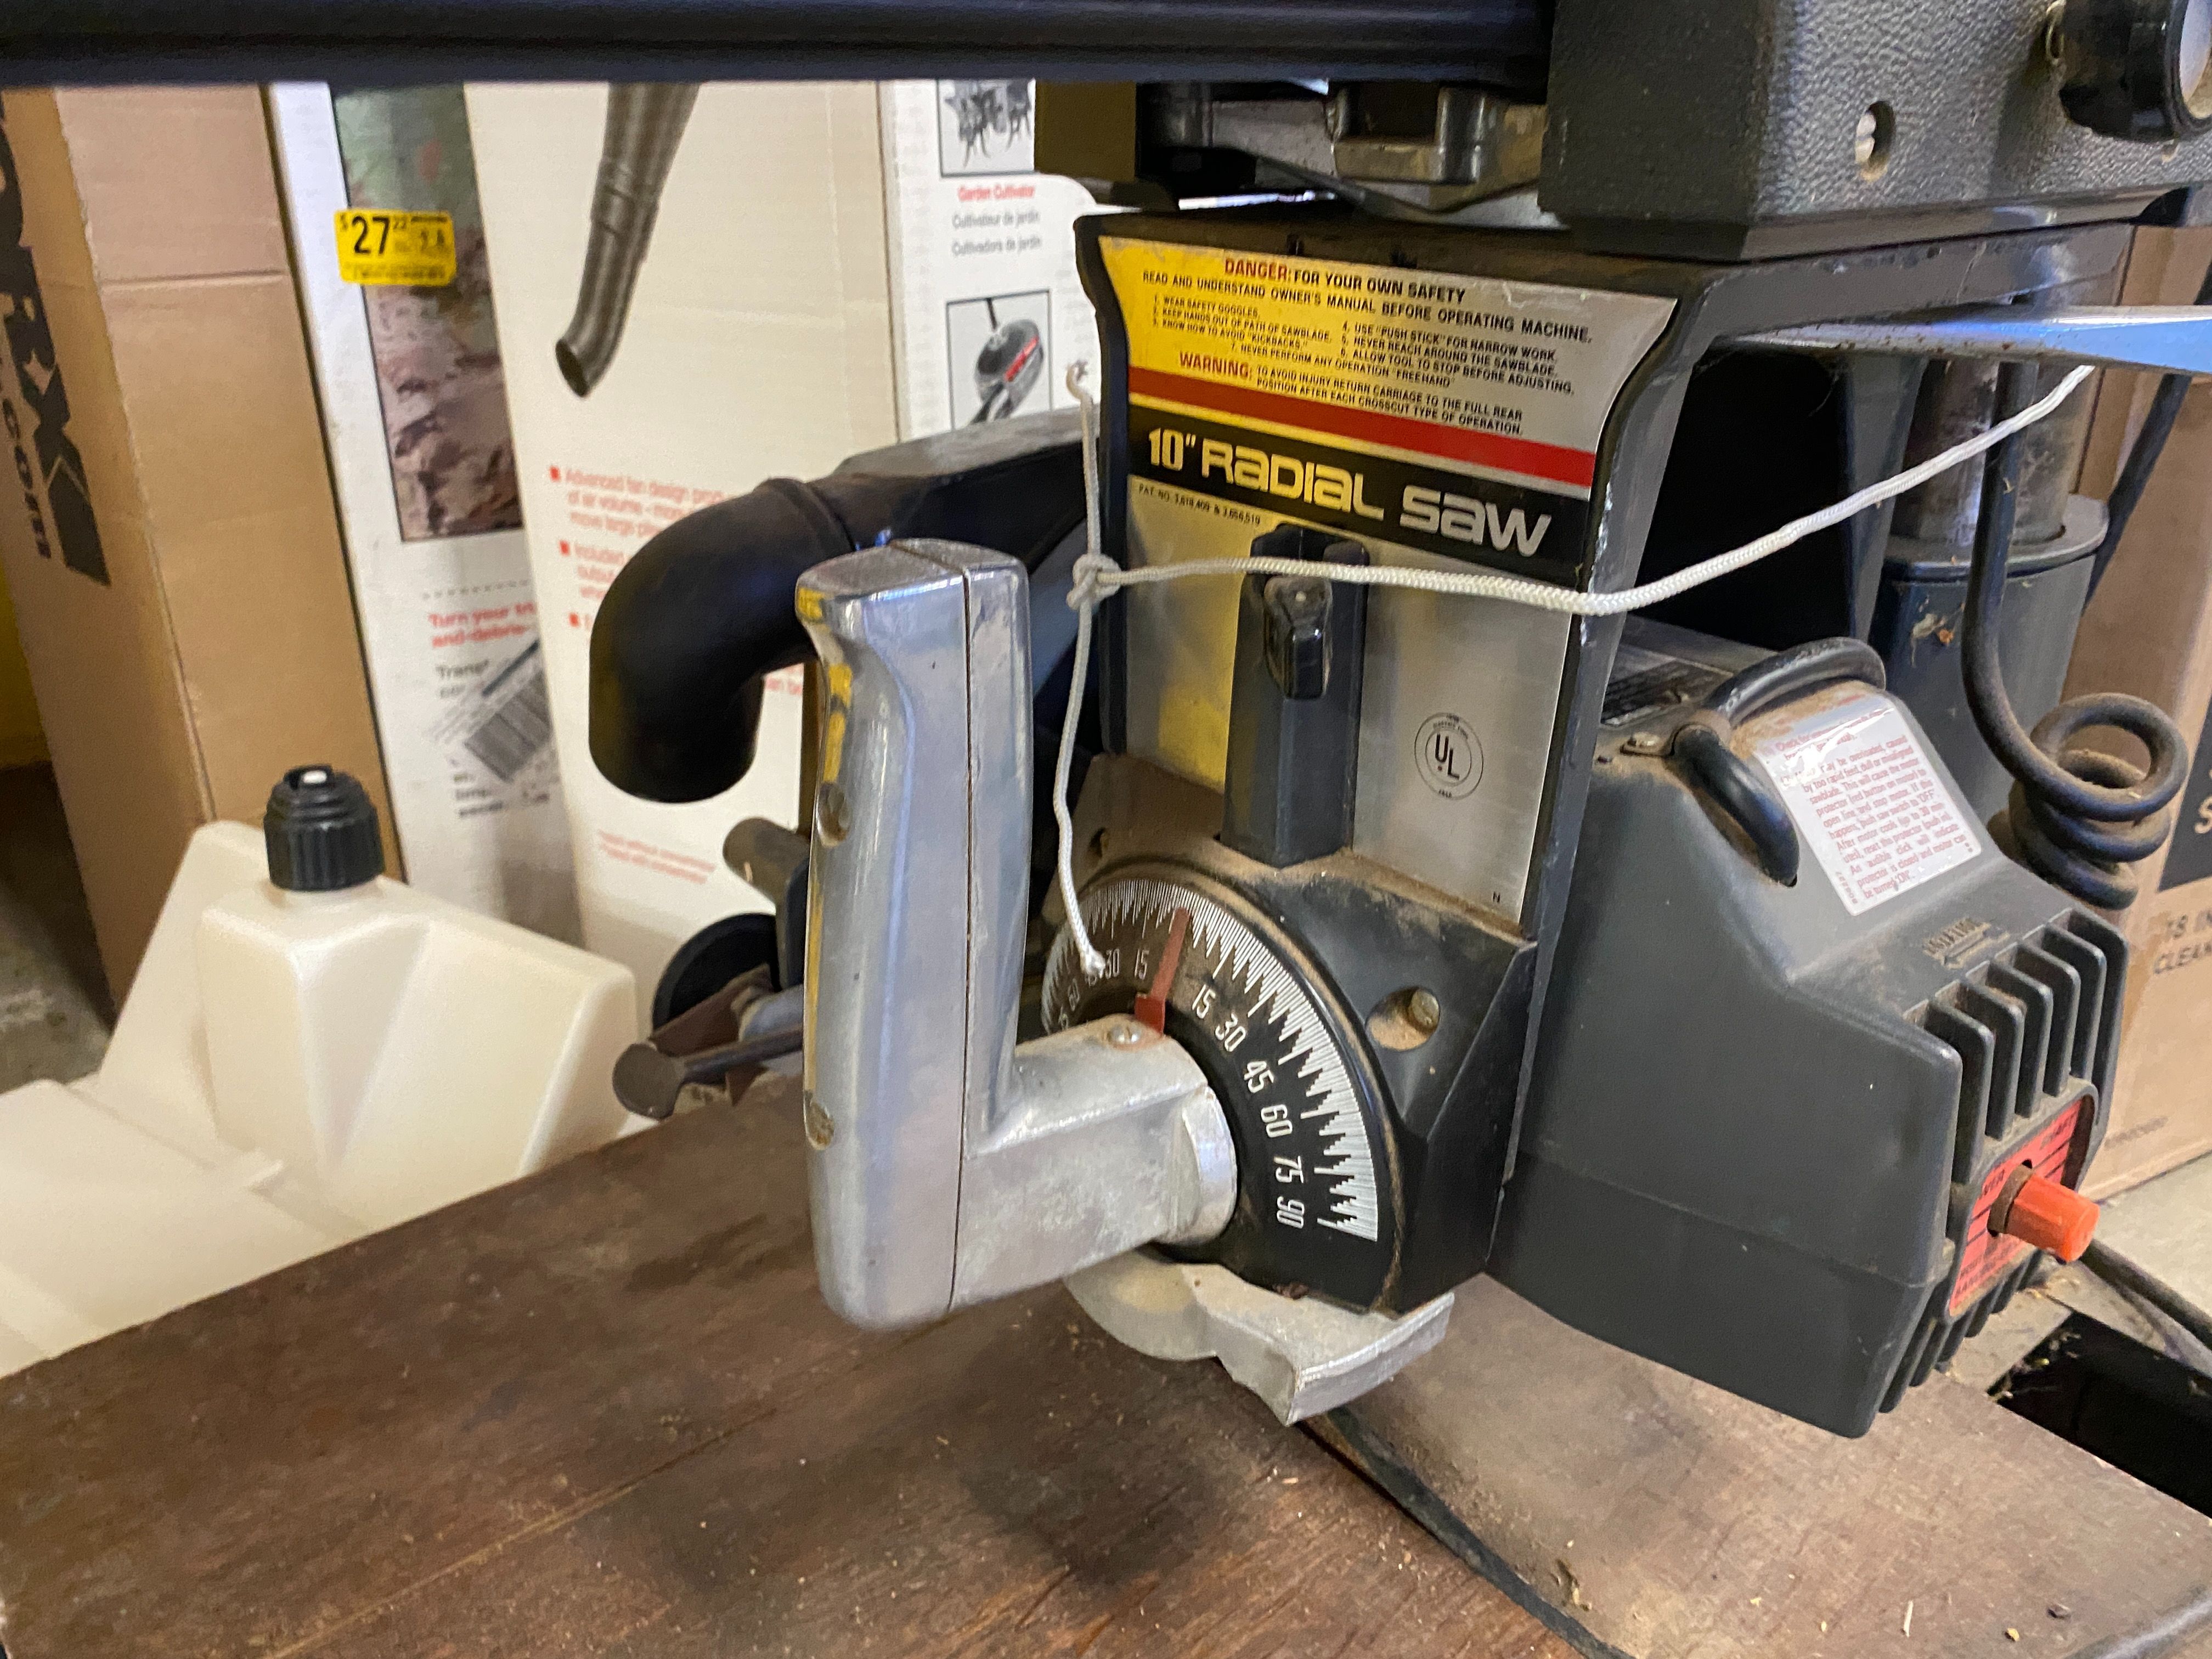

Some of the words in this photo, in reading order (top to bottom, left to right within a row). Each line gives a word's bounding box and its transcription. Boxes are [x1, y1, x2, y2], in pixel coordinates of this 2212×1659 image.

[1164, 296, 1184, 306] WEAR
[1187, 298, 1215, 311] SAFETY
[1294, 269, 1319, 285] FOR
[1326, 272, 1362, 290] YOUR
[1367, 276, 1403, 296] OWN
[1408, 282, 1465, 304] SAFETY
[1143, 270, 1167, 284] READ
[1172, 274, 1192, 288] AND
[1198, 278, 1265, 298] UNDERSTAND
[1271, 288, 1321, 305] OWNER'S
[1328, 294, 1375, 314] MANUAL
[1382, 302, 1431, 321] BEFORE
[1438, 308, 1514, 332] OPERATING
[1521, 318, 1591, 343] MACHINE.
[1163, 308, 1182, 318] KEEP
[1184, 311, 1210, 323] HANDS
[1214, 315, 1228, 326] OUT
[1232, 318, 1242, 328] OF
[1244, 320, 1265, 332] PATH
[1268, 324, 1280, 334] OF
[1163, 319, 1185, 331] KNOW
[1187, 323, 1205, 334] HOW
[1208, 325, 1218, 336] TO
[1220, 328, 1245, 340] AVOID
[1355, 323, 1373, 335] USE
[1447, 335, 1468, 348] FOR
[1470, 338, 1518, 357] NARROW
[1241, 344, 1267, 356] NEVER
[1271, 348, 1312, 363] PERFORM
[1314, 356, 1332, 366] ANY
[1335, 358, 1389, 377] OPERATION
[1354, 337, 1385, 350] NEVER
[1389, 342, 1421, 356] REACH
[1424, 347, 1468, 362] AROUND
[1471, 352, 1491, 365] THE
[1353, 351, 1386, 362] ALLOW
[1389, 354, 1413, 368] TOOL
[1417, 359, 1431, 370] TO
[1433, 360, 1460, 375] STOP
[1463, 365, 1505, 382] BEFORE
[1508, 374, 1575, 395] ADJUSTING.
[1257, 366, 1268, 376] TO
[1271, 368, 1296, 381] AVOID
[1300, 372, 1332, 386] INJURY
[1333, 380, 1370, 394] RETURN
[1374, 385, 1422, 403] CARRIAGE
[1426, 394, 1438, 407] TO
[1442, 397, 1460, 410] THE
[1464, 400, 1487, 414] FULL
[1493, 405, 1522, 421] REAR
[1257, 379, 1296, 394] POSITION
[1300, 386, 1327, 398] AFTER
[1331, 390, 1355, 404] EACH
[1358, 396, 1410, 414] CROSSCUT
[1413, 405, 1437, 420] TYPE
[1441, 411, 1455, 422] OF
[1149, 427, 1196, 471] 10"
[1138, 483, 1154, 495] PAT
[1435, 733, 1460, 781] UL
[1105, 949, 1120, 980] 30
[1133, 949, 1150, 980] 15
[1192, 983, 1217, 1019] 15
[1215, 1012, 1246, 1052] 30
[1244, 1060, 1274, 1094] 45
[1261, 1103, 1293, 1138] 60
[1274, 1155, 1305, 1183] 75
[1277, 1196, 1305, 1229] 90
